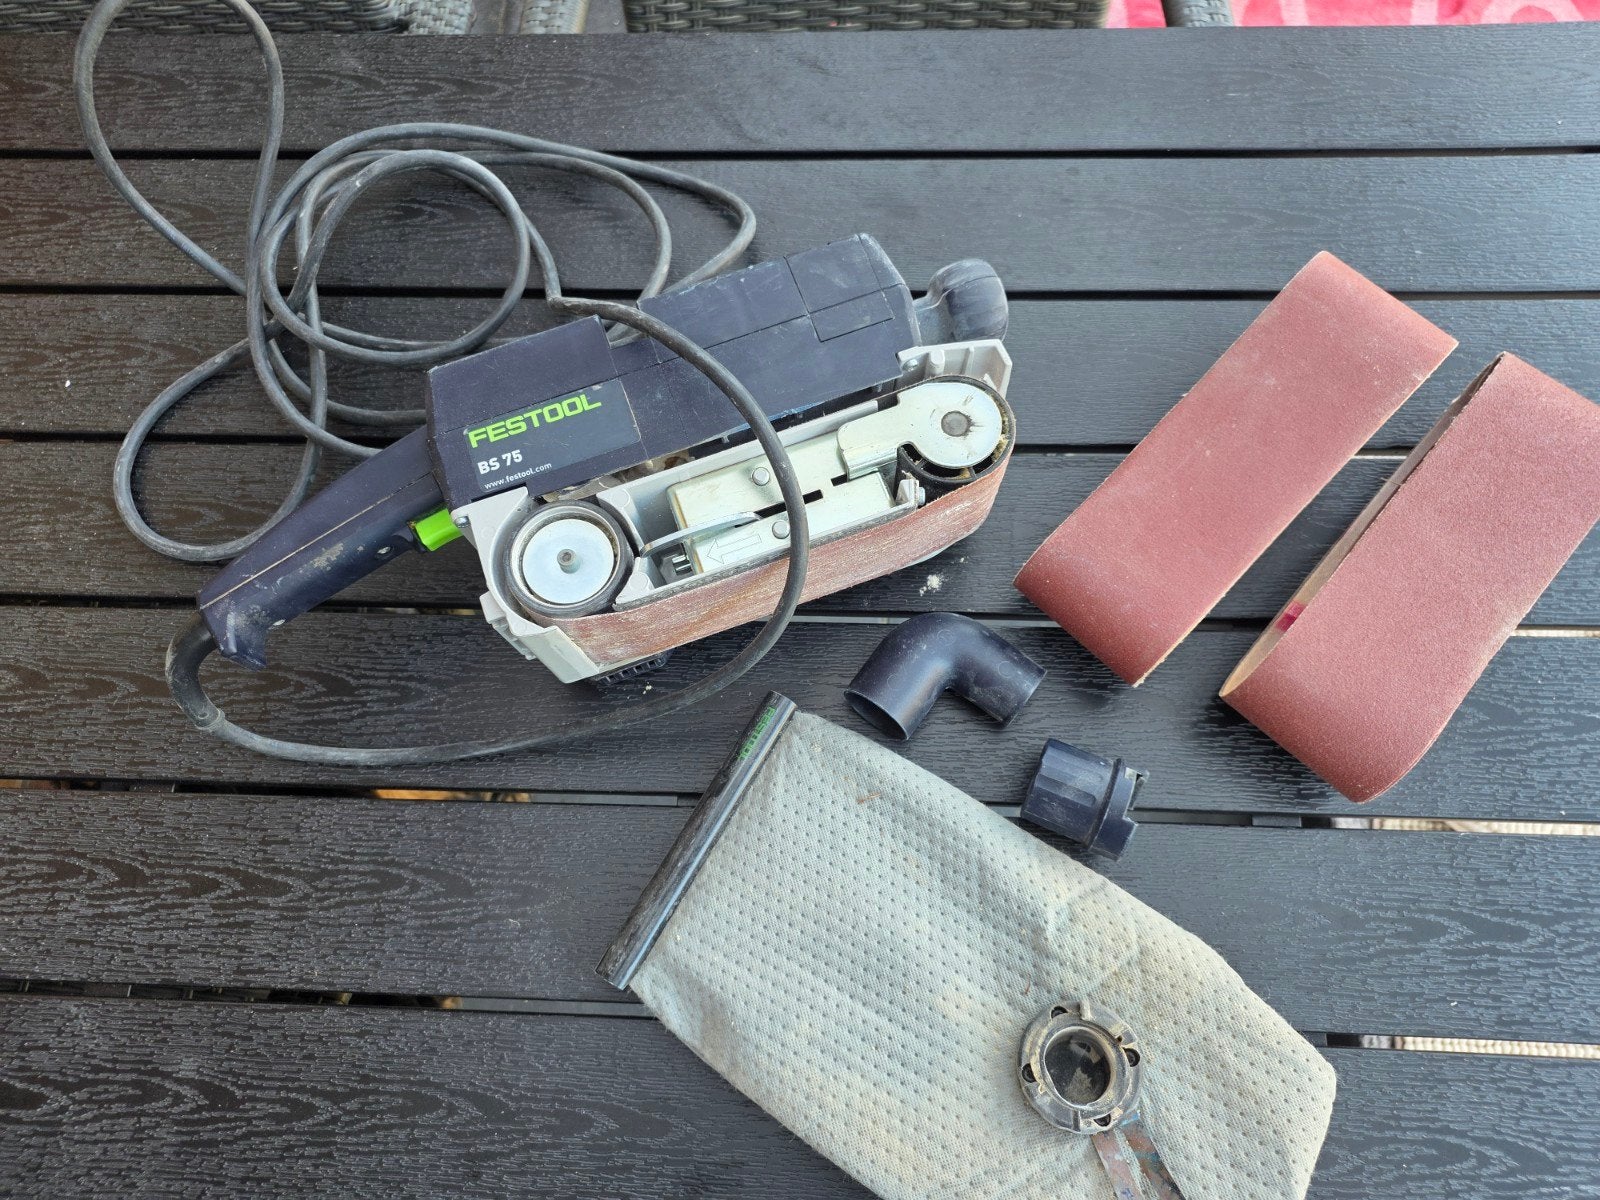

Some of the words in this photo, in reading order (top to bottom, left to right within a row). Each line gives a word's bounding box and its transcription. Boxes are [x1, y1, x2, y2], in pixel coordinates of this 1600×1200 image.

[467, 394, 602, 448] FESTOOL
[477, 456, 500, 475] BS
[502, 449, 523, 466] 75
[484, 462, 552, 490] www.festool.com
